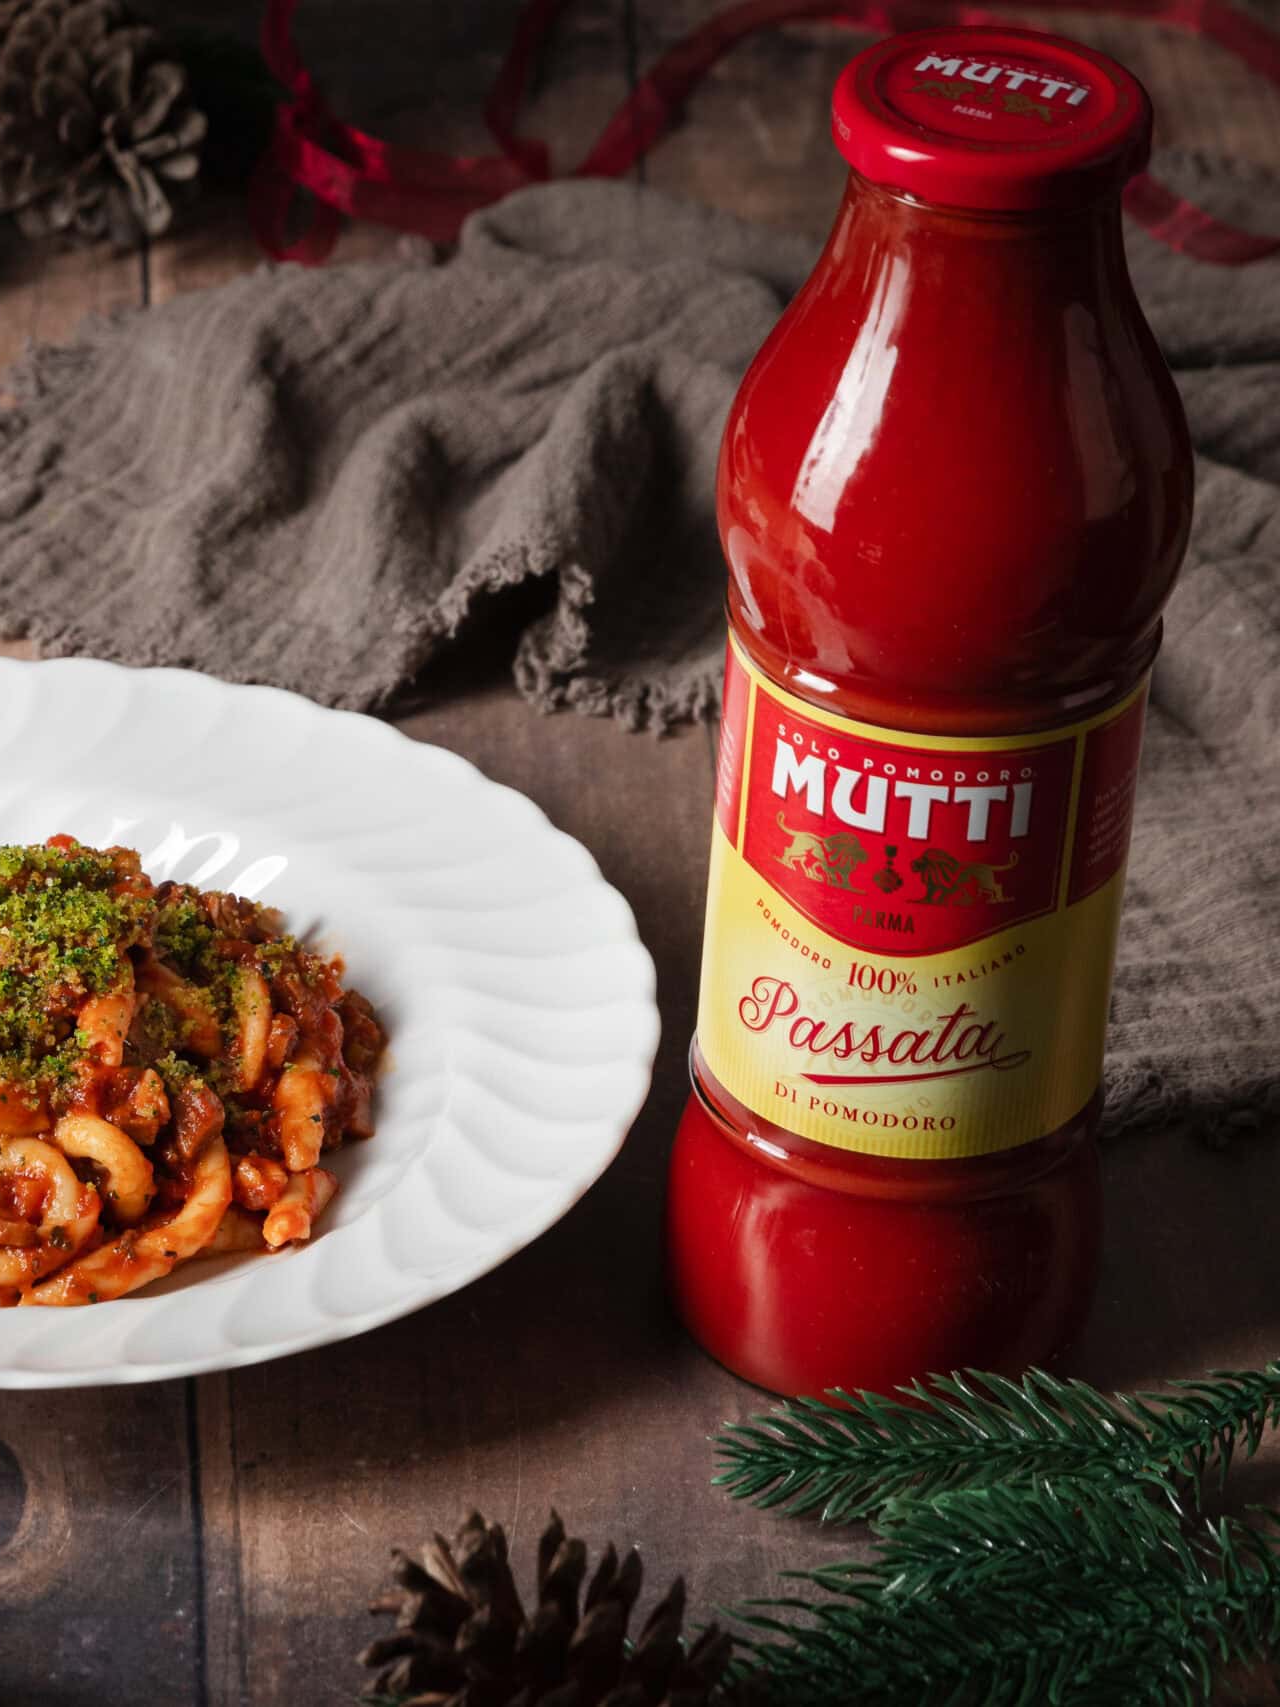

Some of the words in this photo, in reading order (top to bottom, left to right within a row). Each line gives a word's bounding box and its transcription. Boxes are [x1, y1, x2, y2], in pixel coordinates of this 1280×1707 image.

[914, 55, 1088, 107] MUTTI
[777, 722, 841, 761] SOLO
[863, 758, 1033, 783] POMODORO
[771, 737, 1033, 842] MUTTI
[755, 898, 832, 970] POMODORO
[847, 961, 918, 996] 100%
[933, 943, 1026, 989] ITALIANO
[852, 904, 915, 935] PARMA
[738, 975, 1032, 1083] Passata
[774, 1080, 798, 1104] DI
[808, 1095, 958, 1132] POMODORO
